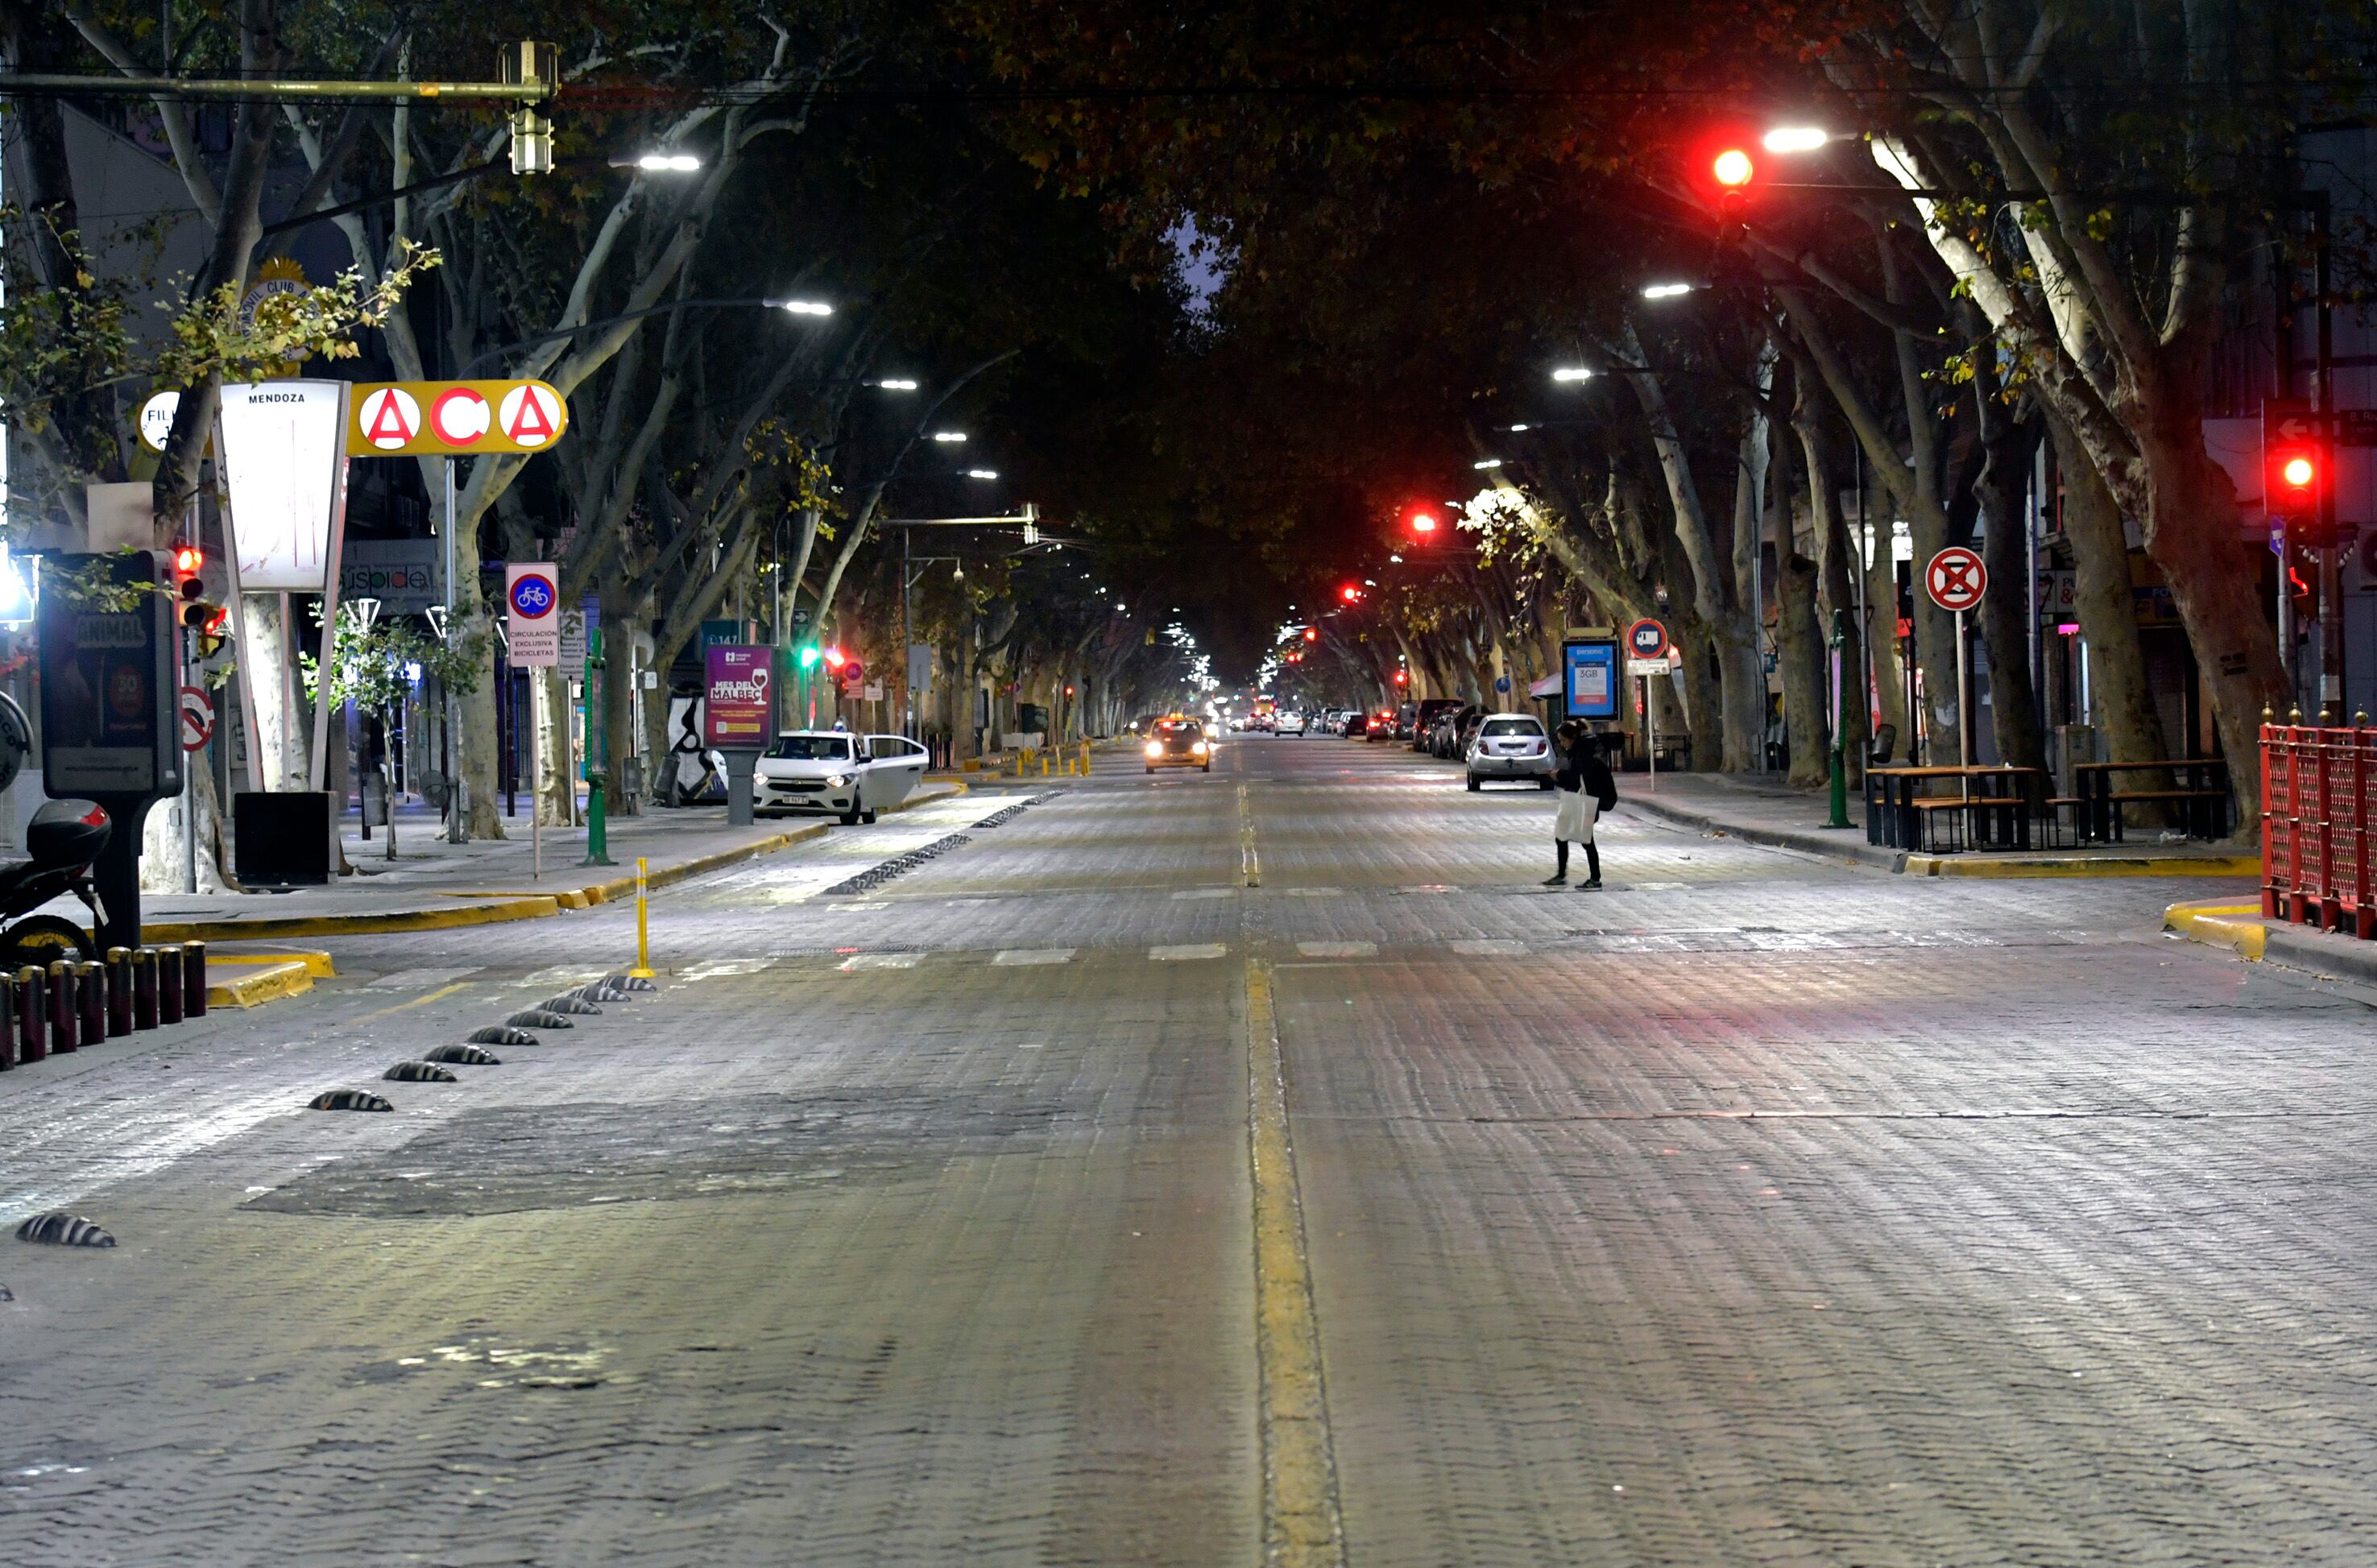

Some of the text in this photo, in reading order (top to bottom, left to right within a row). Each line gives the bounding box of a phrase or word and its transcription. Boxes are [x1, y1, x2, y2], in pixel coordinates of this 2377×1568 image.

[248, 393, 306, 404] MENDOZA
[366, 386, 554, 447] ACA
[510, 630, 557, 638] CIRCULACIÓN
[718, 635, 738, 645] 147
[1580, 669, 1598, 678] 3GB
[715, 681, 752, 689] MES DEL
[712, 689, 761, 700] MALBEC
